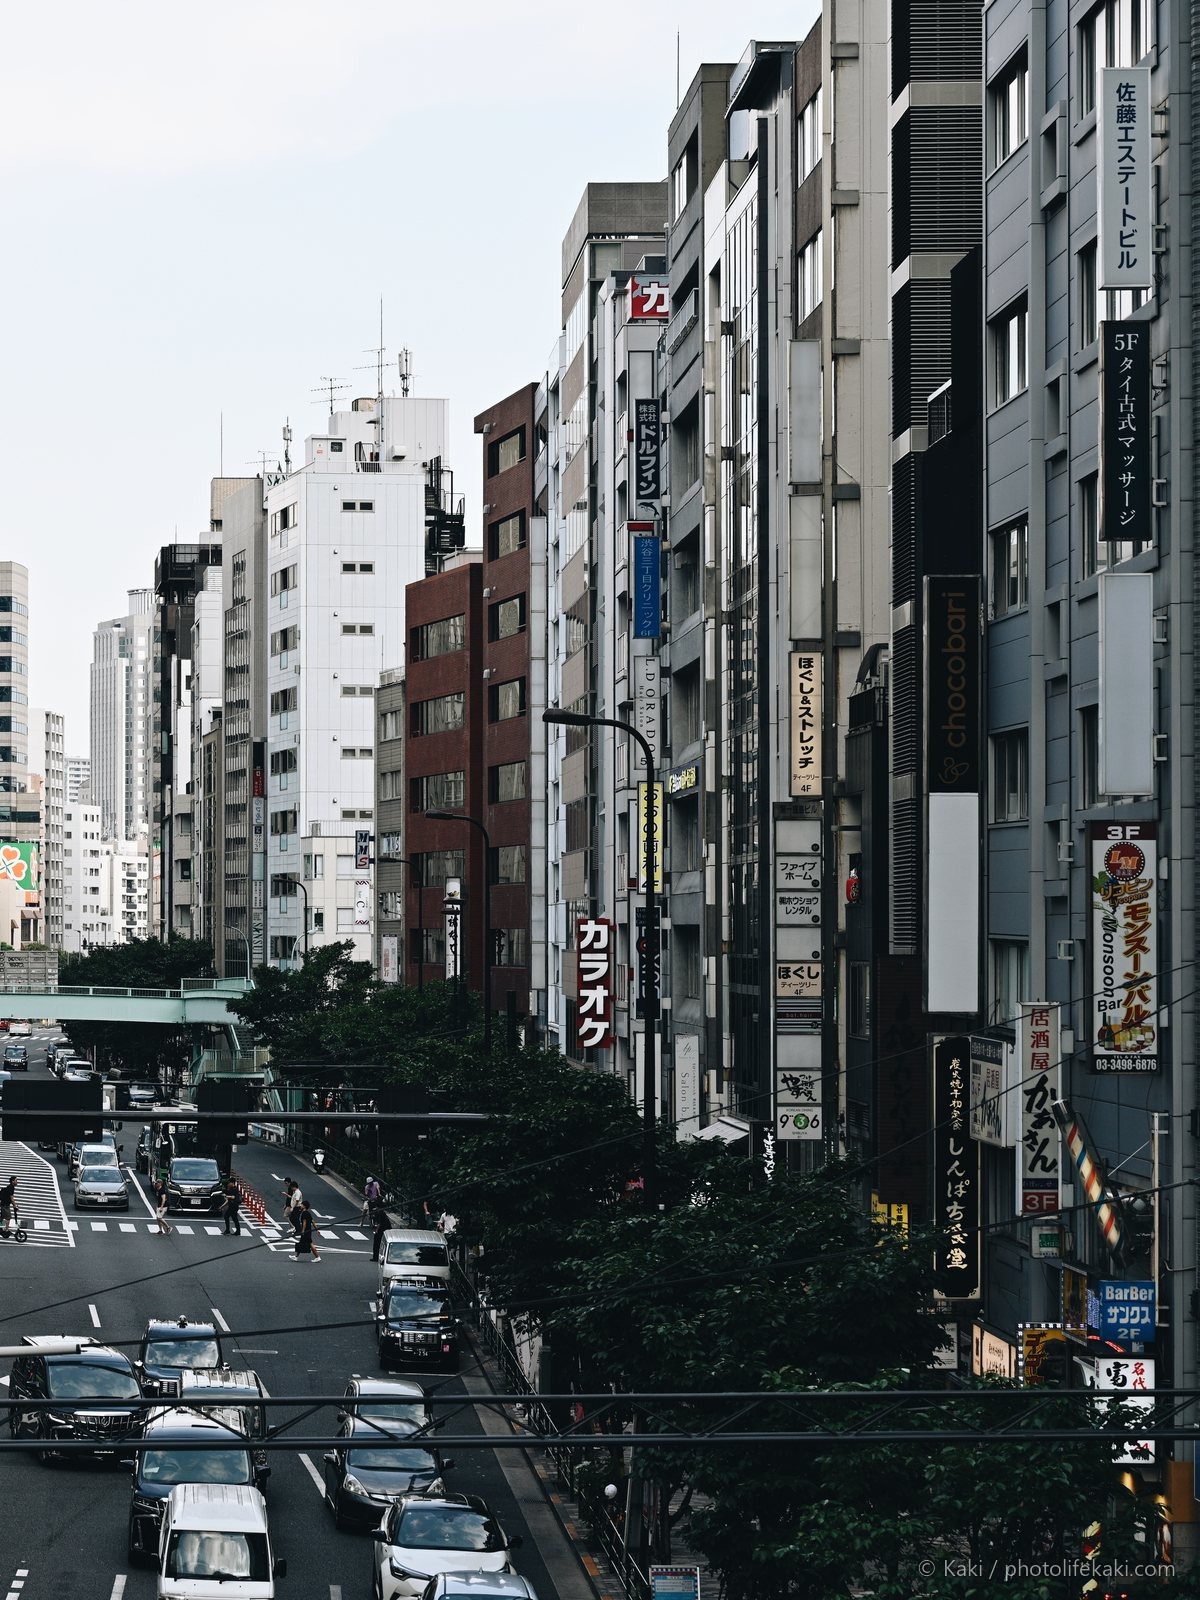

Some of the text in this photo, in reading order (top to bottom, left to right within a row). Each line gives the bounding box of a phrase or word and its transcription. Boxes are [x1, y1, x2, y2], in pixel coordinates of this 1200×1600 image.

[1116, 82, 1137, 270] 佐藤エステートビル
[1114, 332, 1139, 351] 5F
[1118, 356, 1136, 527] タイ古式マッサージ
[638, 424, 658, 496] ドルフィン
[641, 539, 654, 629] 渋谷三丁目クリニック
[640, 629, 653, 637] 6F
[942, 591, 966, 748] chocobari
[798, 656, 814, 769] ほぐし&ストレッチ
[792, 773, 820, 781] ティーツリー
[800, 784, 812, 793] 4F
[1106, 825, 1140, 840] 3F
[785, 871, 813, 881] ホーム
[1100, 878, 1154, 901] リコピン
[785, 906, 812, 916] レンタル
[1099, 917, 1119, 998] Monsoon
[1122, 903, 1153, 1027] モンスーンバル
[778, 965, 820, 980] ほぐし
[578, 920, 610, 1048] カラオケ
[780, 981, 818, 989] ティーツリー
[1097, 998, 1123, 1012] Bar
[1029, 1008, 1050, 1071] 居酒屋
[1096, 1058, 1157, 1071] 03-3498-6876
[1025, 1195, 1057, 1210] 3F
[1105, 1285, 1154, 1301] BarBer
[1107, 1307, 1151, 1324] サンクス
[1117, 1328, 1141, 1340] 2F
